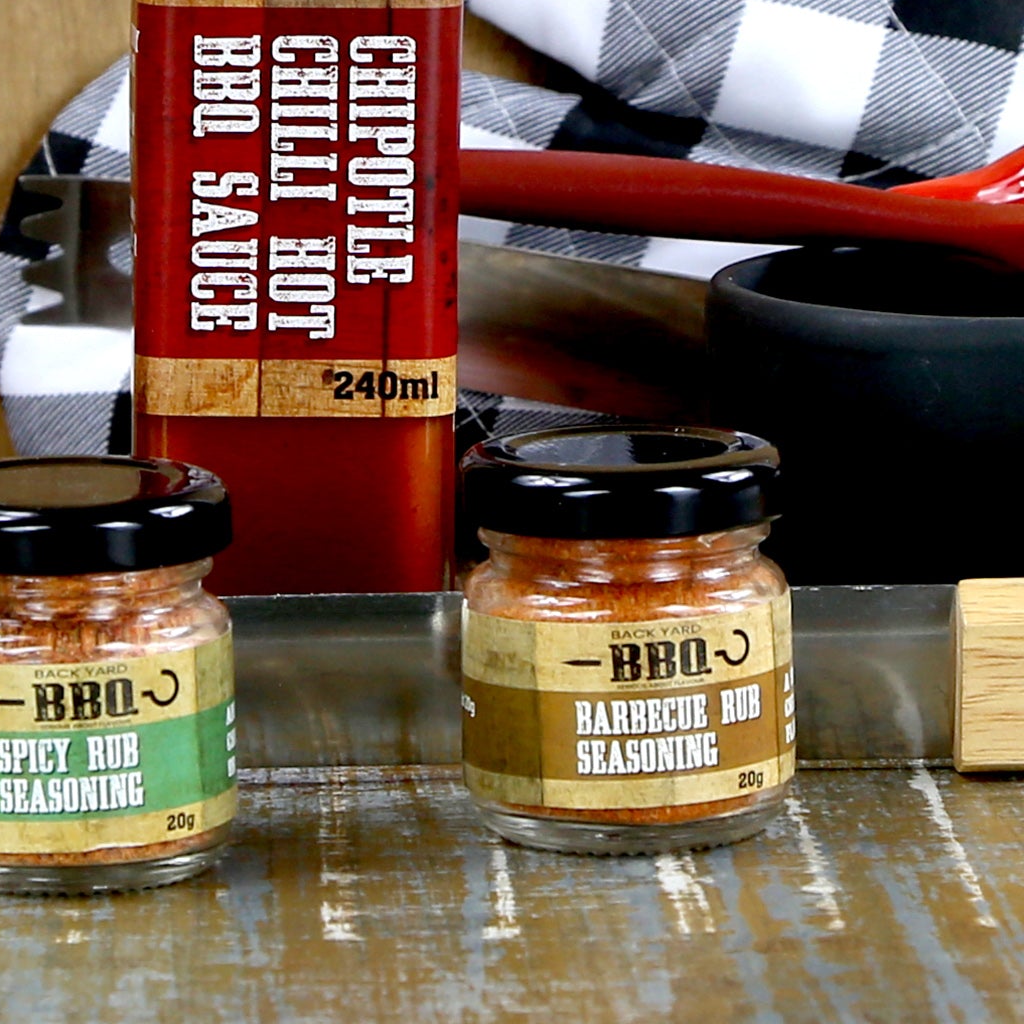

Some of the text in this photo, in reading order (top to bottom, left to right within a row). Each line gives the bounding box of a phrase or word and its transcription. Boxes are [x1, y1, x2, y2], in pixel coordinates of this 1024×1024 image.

[347, 34, 417, 285] CHIPOTLE
[190, 34, 262, 332] BBQ SAUCE
[268, 34, 339, 340] CHILLI HOT
[333, 370, 440, 400] 240ml
[611, 624, 702, 640] BACK YARD
[34, 663, 129, 679] BACK YARD
[608, 638, 712, 682] BBQ
[32, 678, 139, 722] BBQ
[575, 694, 708, 737] BARBECUE
[720, 683, 762, 725] RUB
[86, 732, 140, 772] RUB
[577, 732, 719, 775] SEASONING
[738, 771, 764, 789] 20g
[166, 813, 195, 831] 20g
